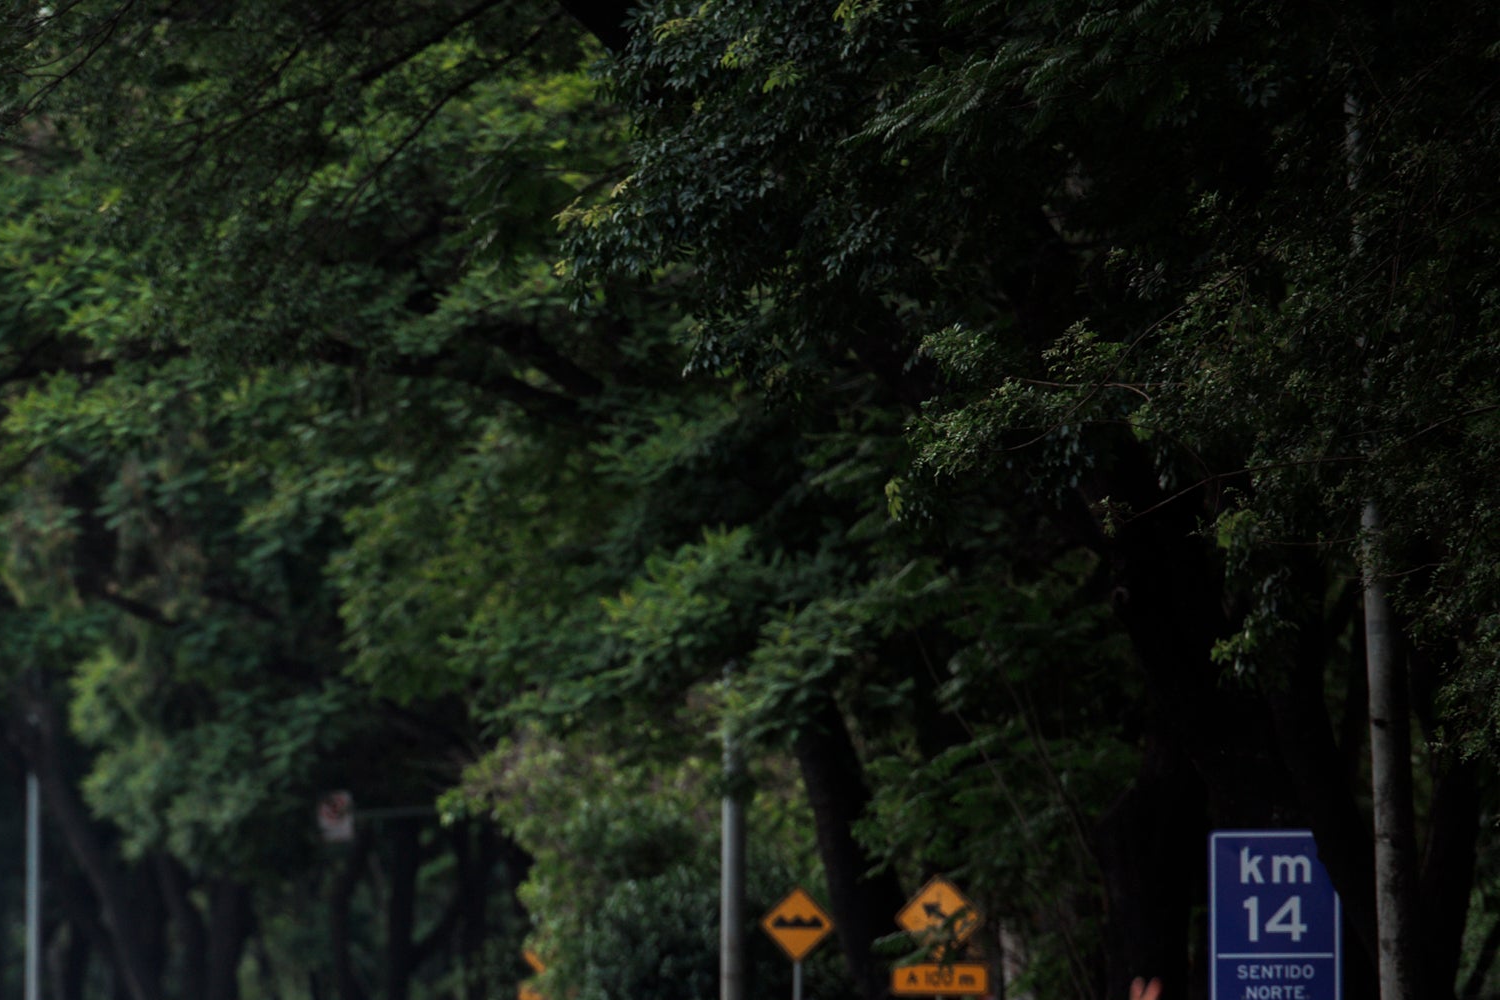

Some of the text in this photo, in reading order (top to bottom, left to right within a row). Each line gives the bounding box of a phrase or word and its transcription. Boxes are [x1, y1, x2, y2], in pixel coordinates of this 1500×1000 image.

[1240, 847, 1312, 884] km
[1243, 895, 1308, 942] 14
[906, 970, 918, 986] A
[1237, 964, 1315, 980] SENTIDO
[1246, 985, 1305, 1000] NORTE
